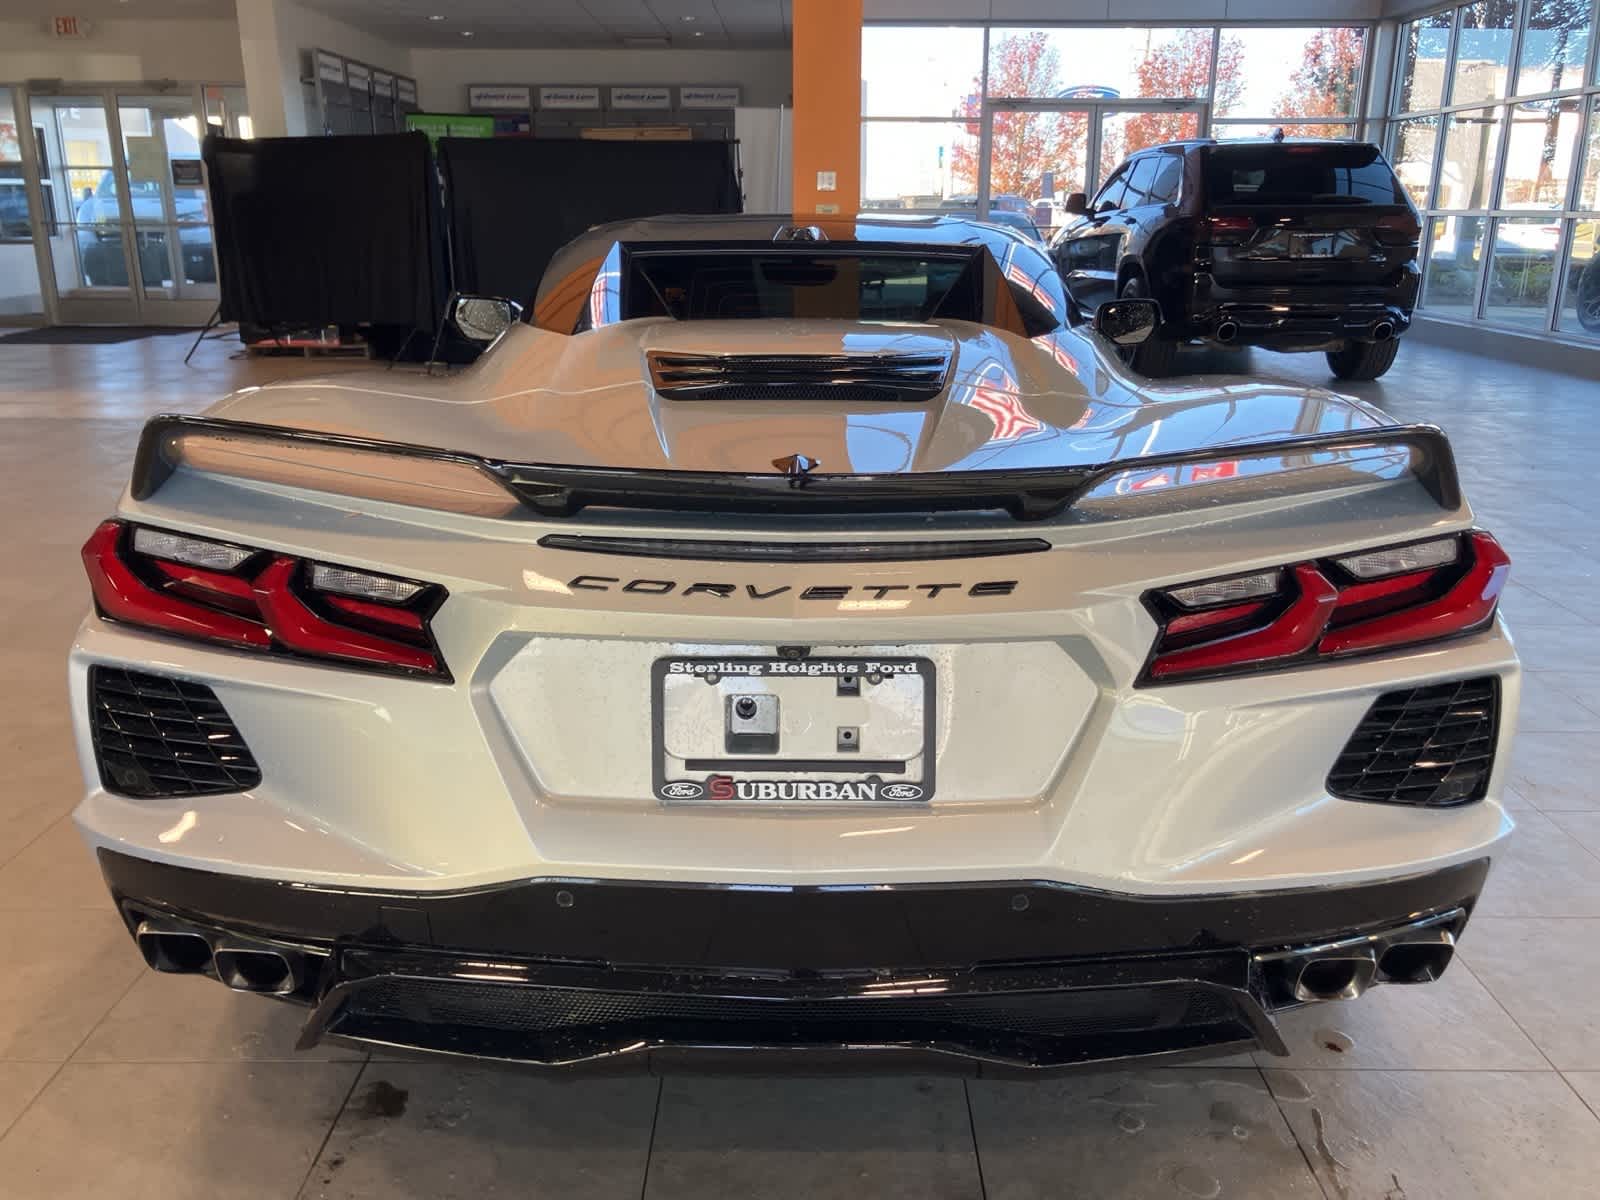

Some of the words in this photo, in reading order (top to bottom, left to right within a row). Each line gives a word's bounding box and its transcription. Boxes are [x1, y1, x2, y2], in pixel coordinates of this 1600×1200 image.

[55, 16, 78, 34] EXIT
[567, 575, 1019, 599] CORVETTE
[669, 662, 762, 675] Sterling
[768, 662, 858, 675] Heights
[865, 662, 918, 674] Ford
[709, 776, 876, 800] SUBURBAN
